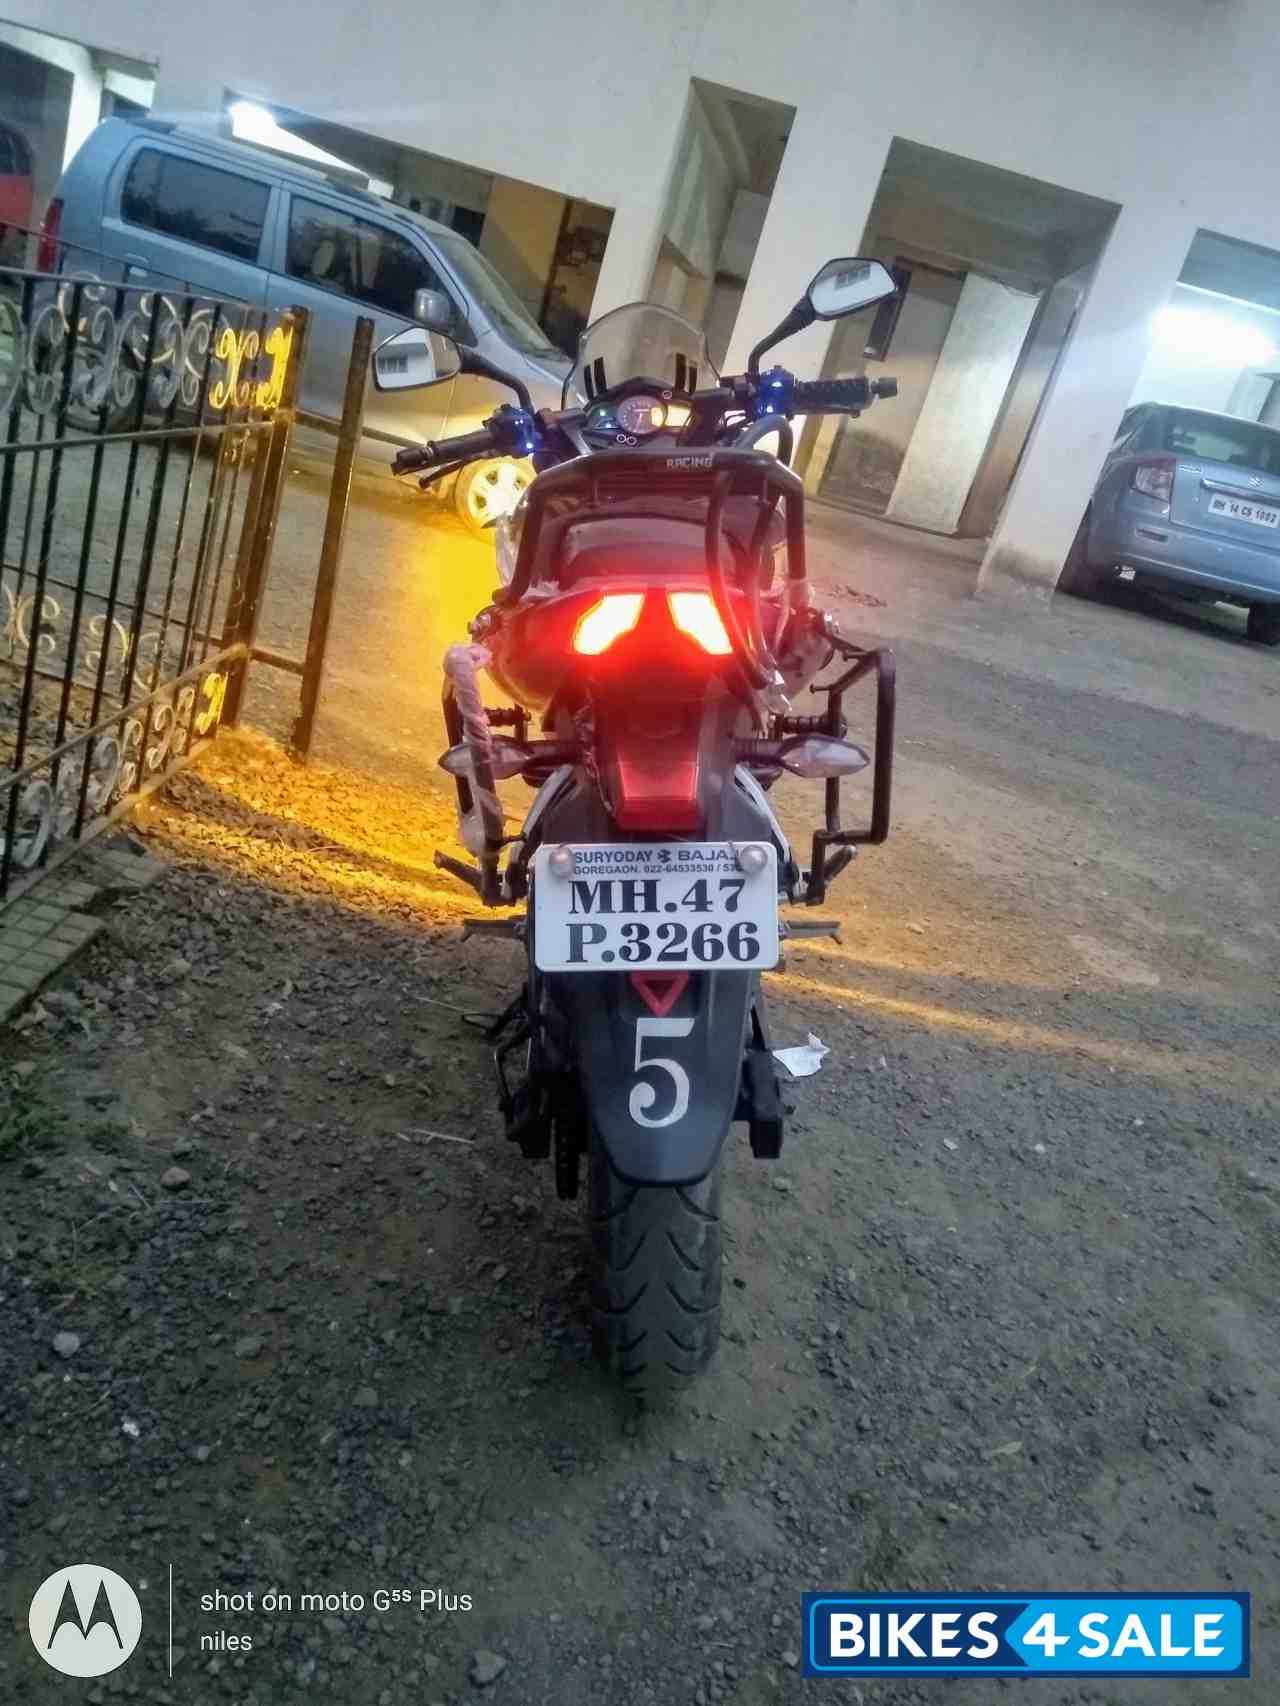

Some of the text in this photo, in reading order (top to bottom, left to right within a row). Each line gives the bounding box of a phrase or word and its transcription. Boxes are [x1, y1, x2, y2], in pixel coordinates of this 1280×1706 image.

[666, 456, 713, 469] RACING
[575, 850, 651, 864] SURYODAY
[568, 878, 746, 914] MH.47
[565, 922, 760, 963] P.3266
[629, 1017, 695, 1128] 5
